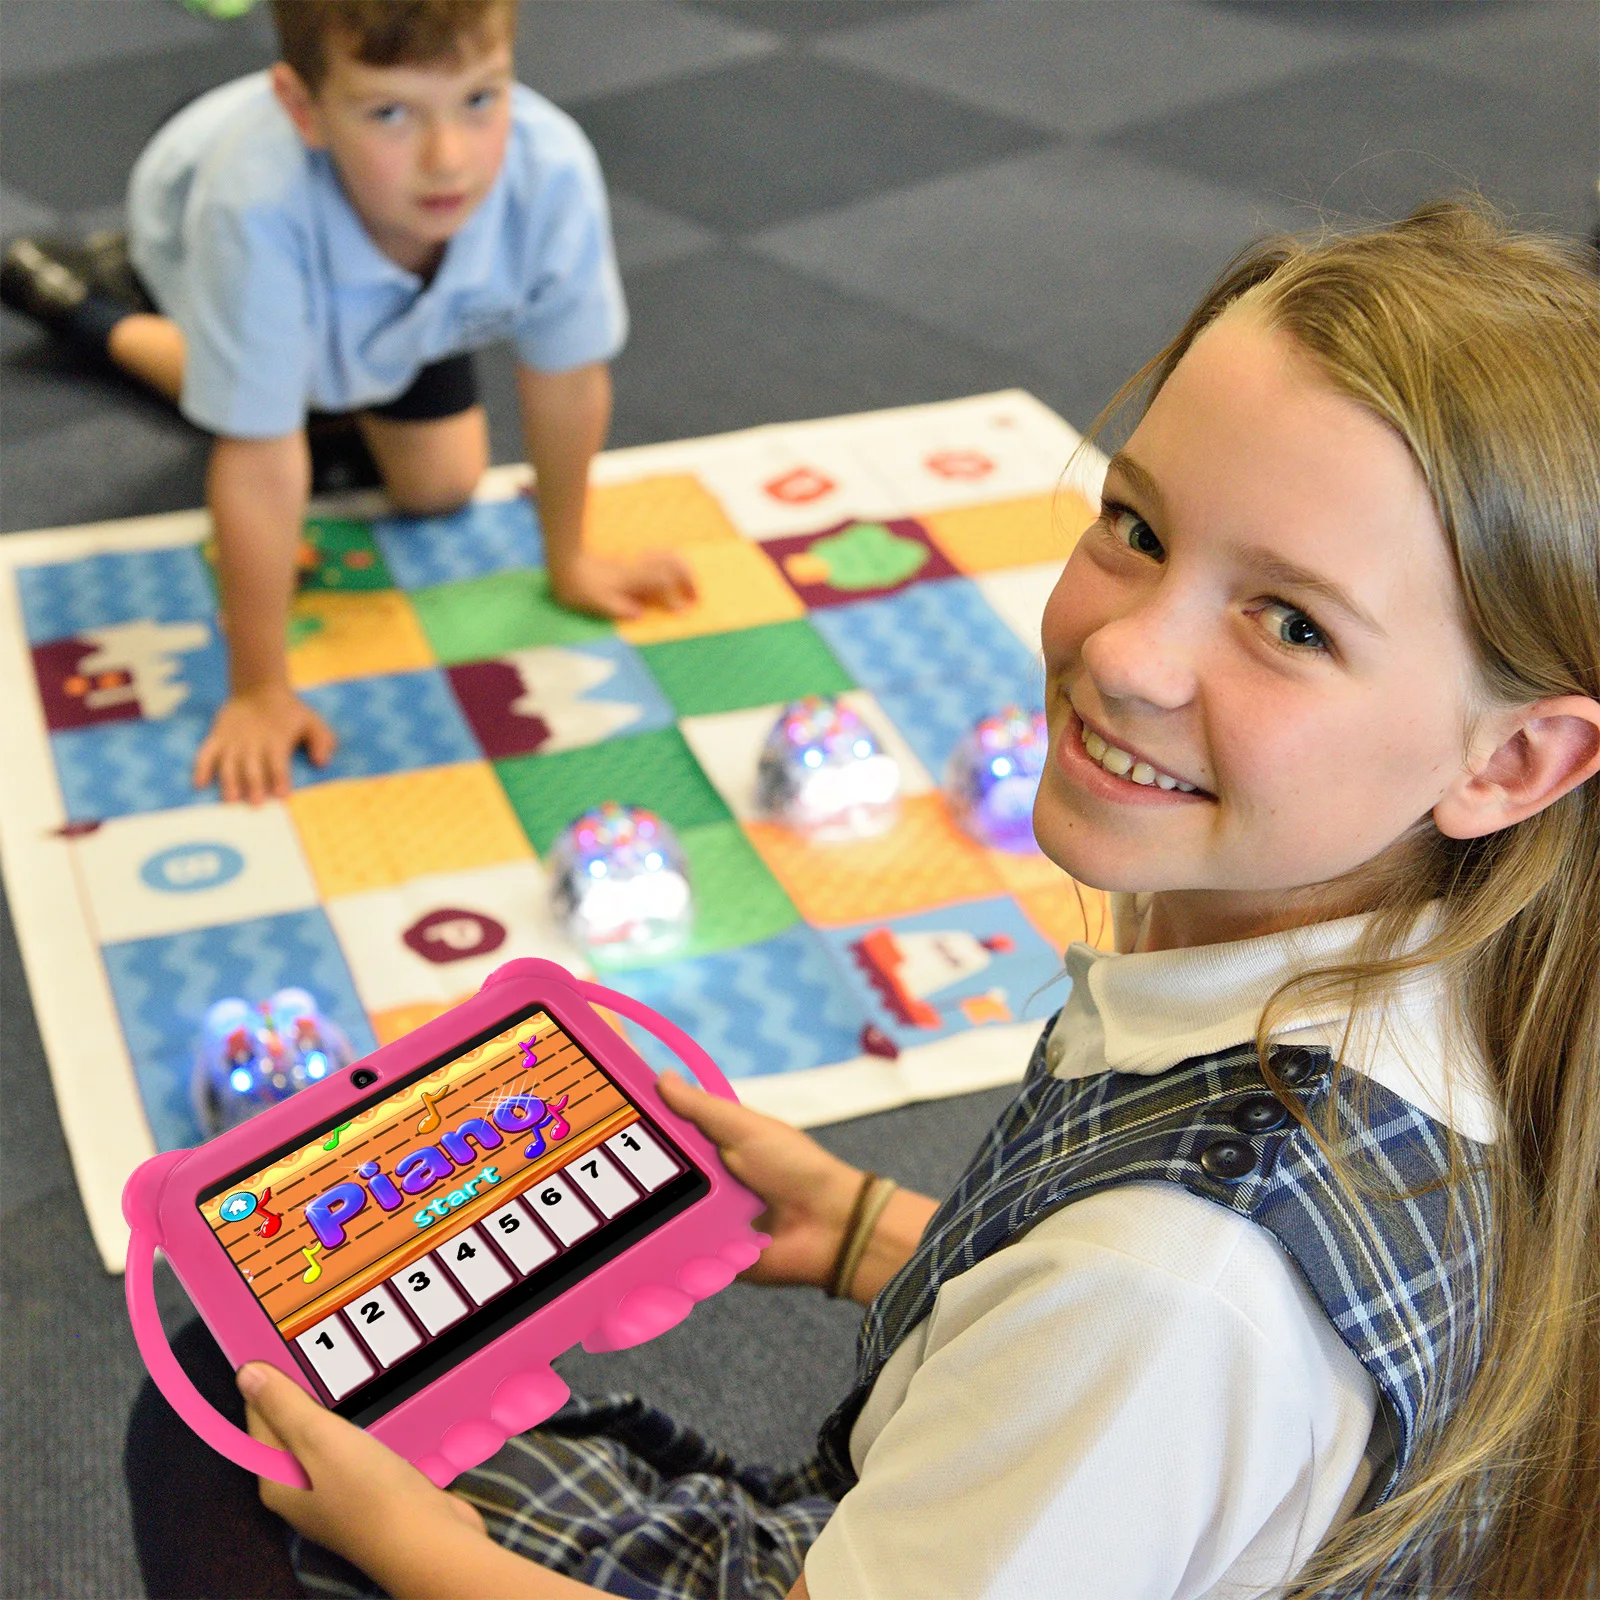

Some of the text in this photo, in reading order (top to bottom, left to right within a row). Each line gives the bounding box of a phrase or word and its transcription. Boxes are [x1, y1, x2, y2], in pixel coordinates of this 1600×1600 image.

[304, 1093, 548, 1250] Piano
[413, 1166, 502, 1229] start
[315, 1331, 335, 1350] 1
[360, 1301, 386, 1325] 2
[408, 1271, 431, 1292] 3
[456, 1242, 477, 1262] 4
[498, 1213, 520, 1234] 5
[540, 1187, 563, 1206] 6
[580, 1159, 599, 1179] 7
